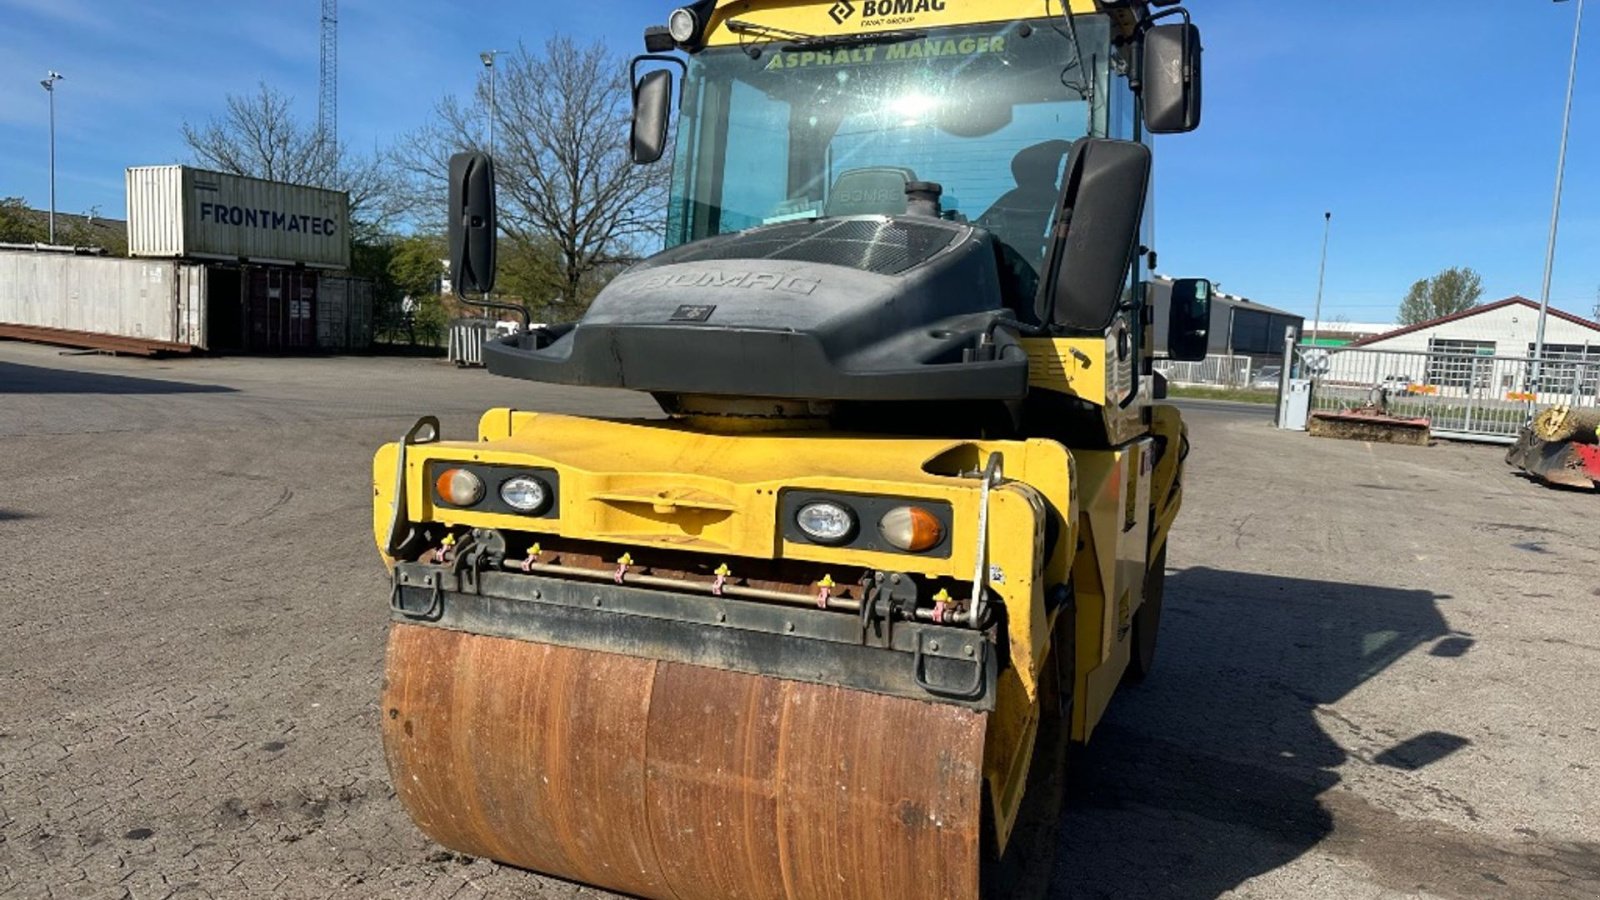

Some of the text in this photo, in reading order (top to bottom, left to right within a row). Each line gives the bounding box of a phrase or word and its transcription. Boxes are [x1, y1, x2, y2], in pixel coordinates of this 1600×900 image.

[862, 0, 946, 17] BOMAG
[885, 36, 1005, 60] MANAGER
[200, 202, 335, 237] FRONTMATEC
